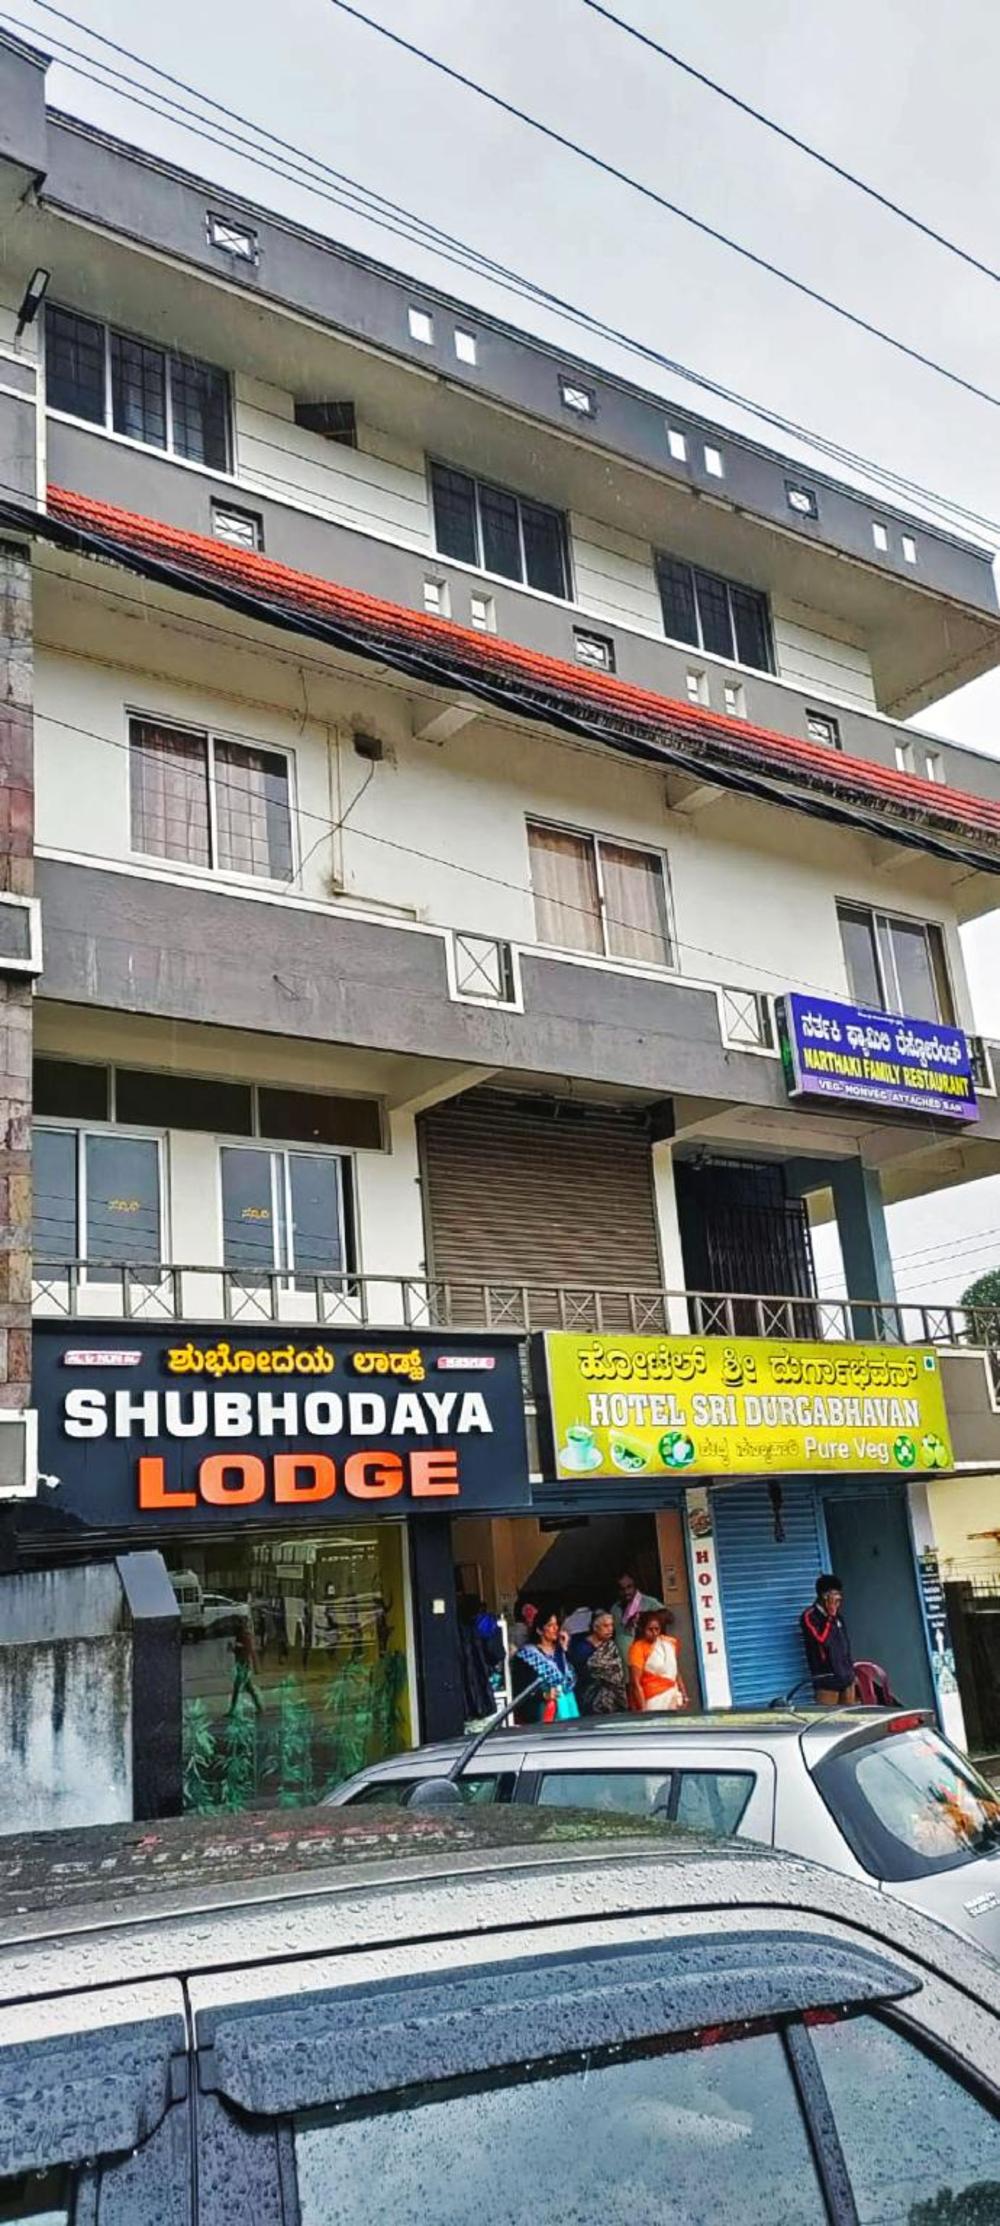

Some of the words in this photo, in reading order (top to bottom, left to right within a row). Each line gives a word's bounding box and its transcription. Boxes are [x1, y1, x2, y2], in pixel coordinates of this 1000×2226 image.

[804, 1048, 863, 1079] NARTHAKI
[864, 1058, 900, 1085] FAMILY
[904, 1066, 969, 1097] RESTAURANT
[892, 1094, 941, 1110] ATTACHED
[942, 1102, 963, 1113] BAR
[167, 1343, 335, 1377] ಶುಭೋದಯ
[353, 1347, 425, 1381] ಲಾಡ್ಜ್
[577, 1341, 707, 1381] ಹೋಟೆಲ್
[720, 1346, 758, 1387] ಶ್ರೀ
[769, 1348, 919, 1391] ದುರ್ಗಾಭವನ್
[63, 1388, 494, 1438] SHUBHODAYA
[588, 1393, 687, 1428] HOTEL
[692, 1395, 739, 1428] SRI
[746, 1395, 921, 1428] DURGABHAVAN
[805, 1437, 851, 1460] Pure
[855, 1437, 890, 1463] Veg
[137, 1450, 461, 1510] LODGE
[695, 1550, 718, 1655] HOTEL
